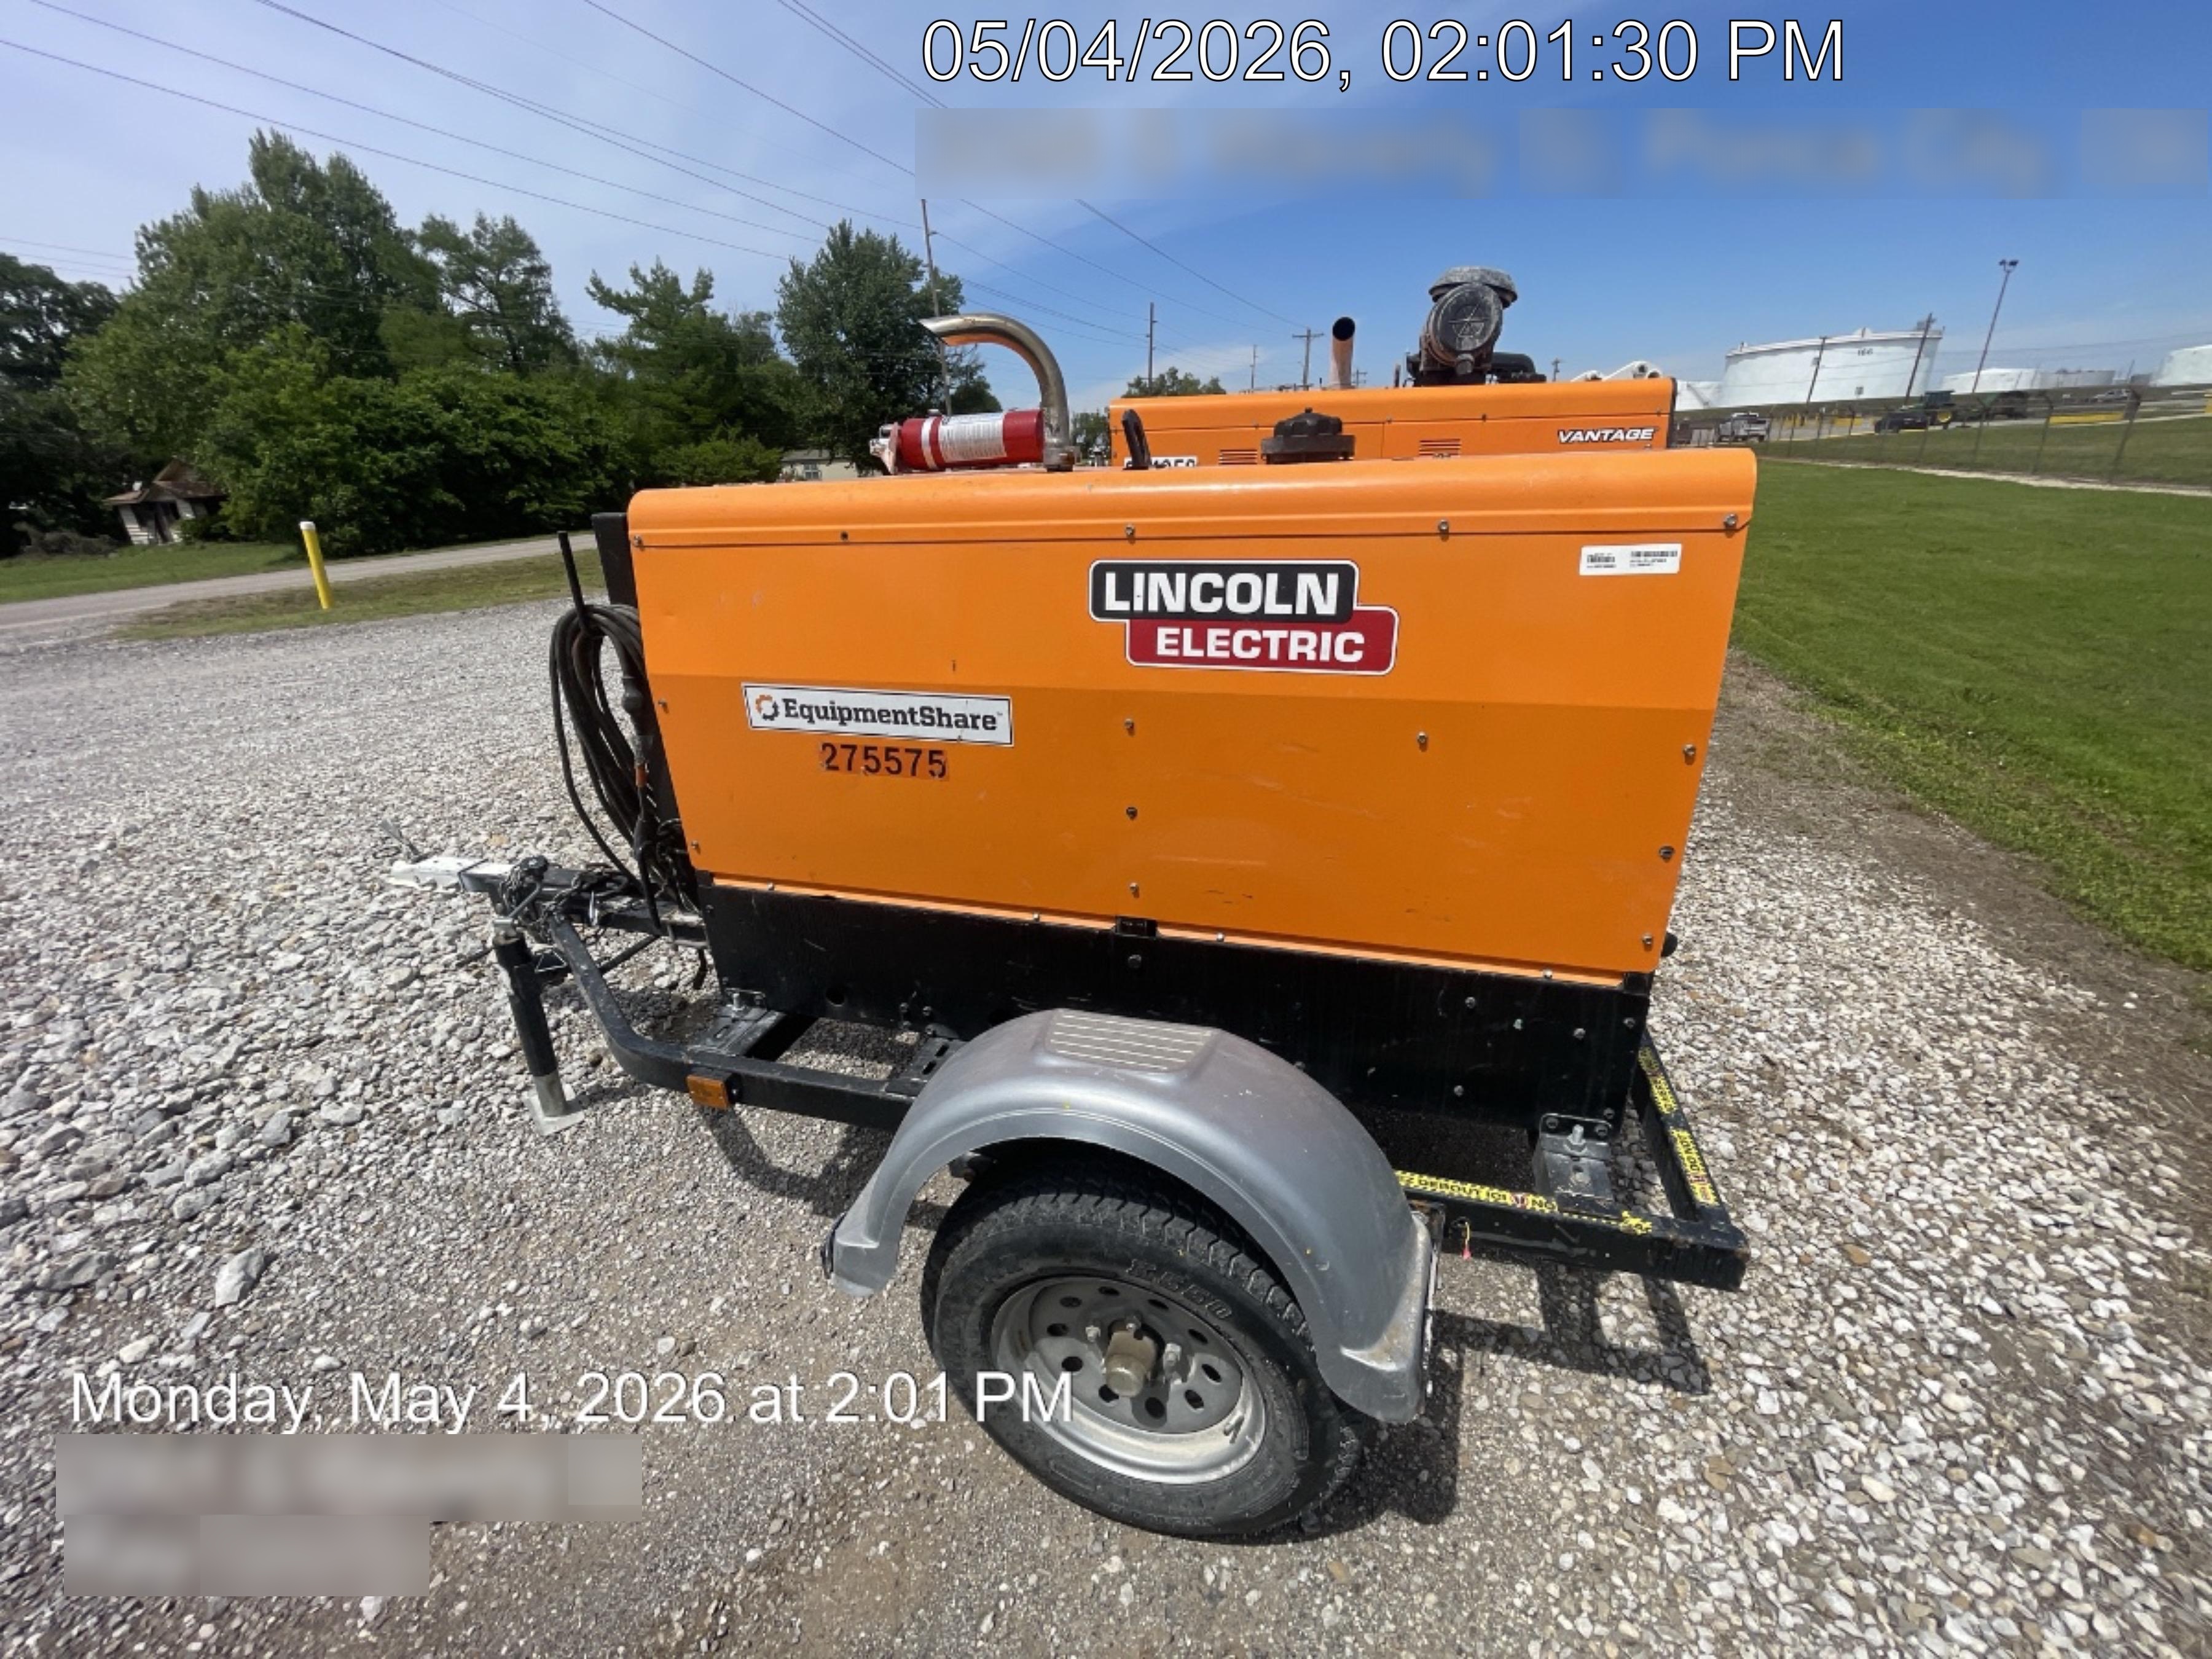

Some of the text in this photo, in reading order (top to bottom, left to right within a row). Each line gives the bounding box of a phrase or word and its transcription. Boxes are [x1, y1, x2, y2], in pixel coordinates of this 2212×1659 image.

[1558, 428, 1655, 443] VANTAGE
[1104, 571, 1339, 615] LINCOLN
[1156, 627, 1365, 662] ELECTRIC
[782, 698, 997, 731] EquipmentShare
[822, 742, 947, 778] 275575
